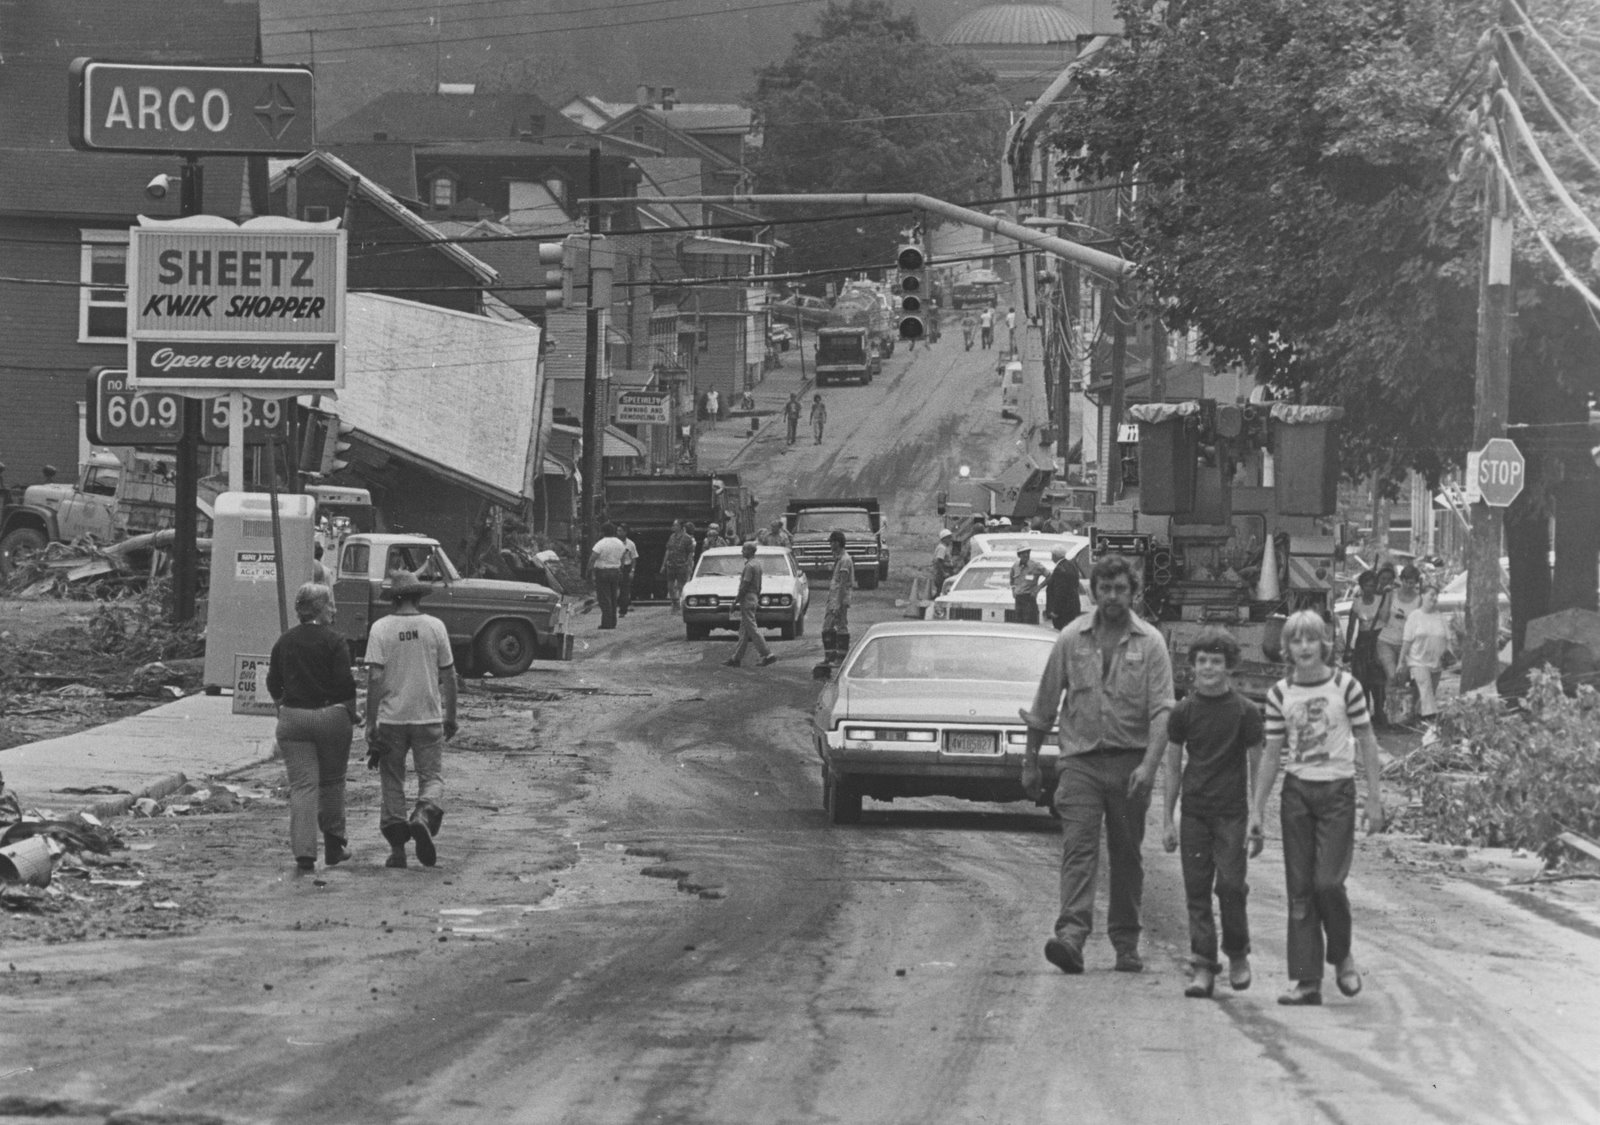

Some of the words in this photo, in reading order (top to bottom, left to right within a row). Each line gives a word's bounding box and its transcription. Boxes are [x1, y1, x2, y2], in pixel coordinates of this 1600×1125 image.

[104, 86, 231, 132] ARCO
[158, 249, 315, 287] SHEETZ
[142, 295, 218, 317] KWIK
[224, 295, 326, 318] SHOPPER
[150, 348, 214, 372] Open
[107, 379, 123, 391] no
[108, 395, 177, 428] 60.9
[1480, 460, 1521, 485] STOP
[262, 568, 275, 576] INC
[398, 630, 419, 642] DON
